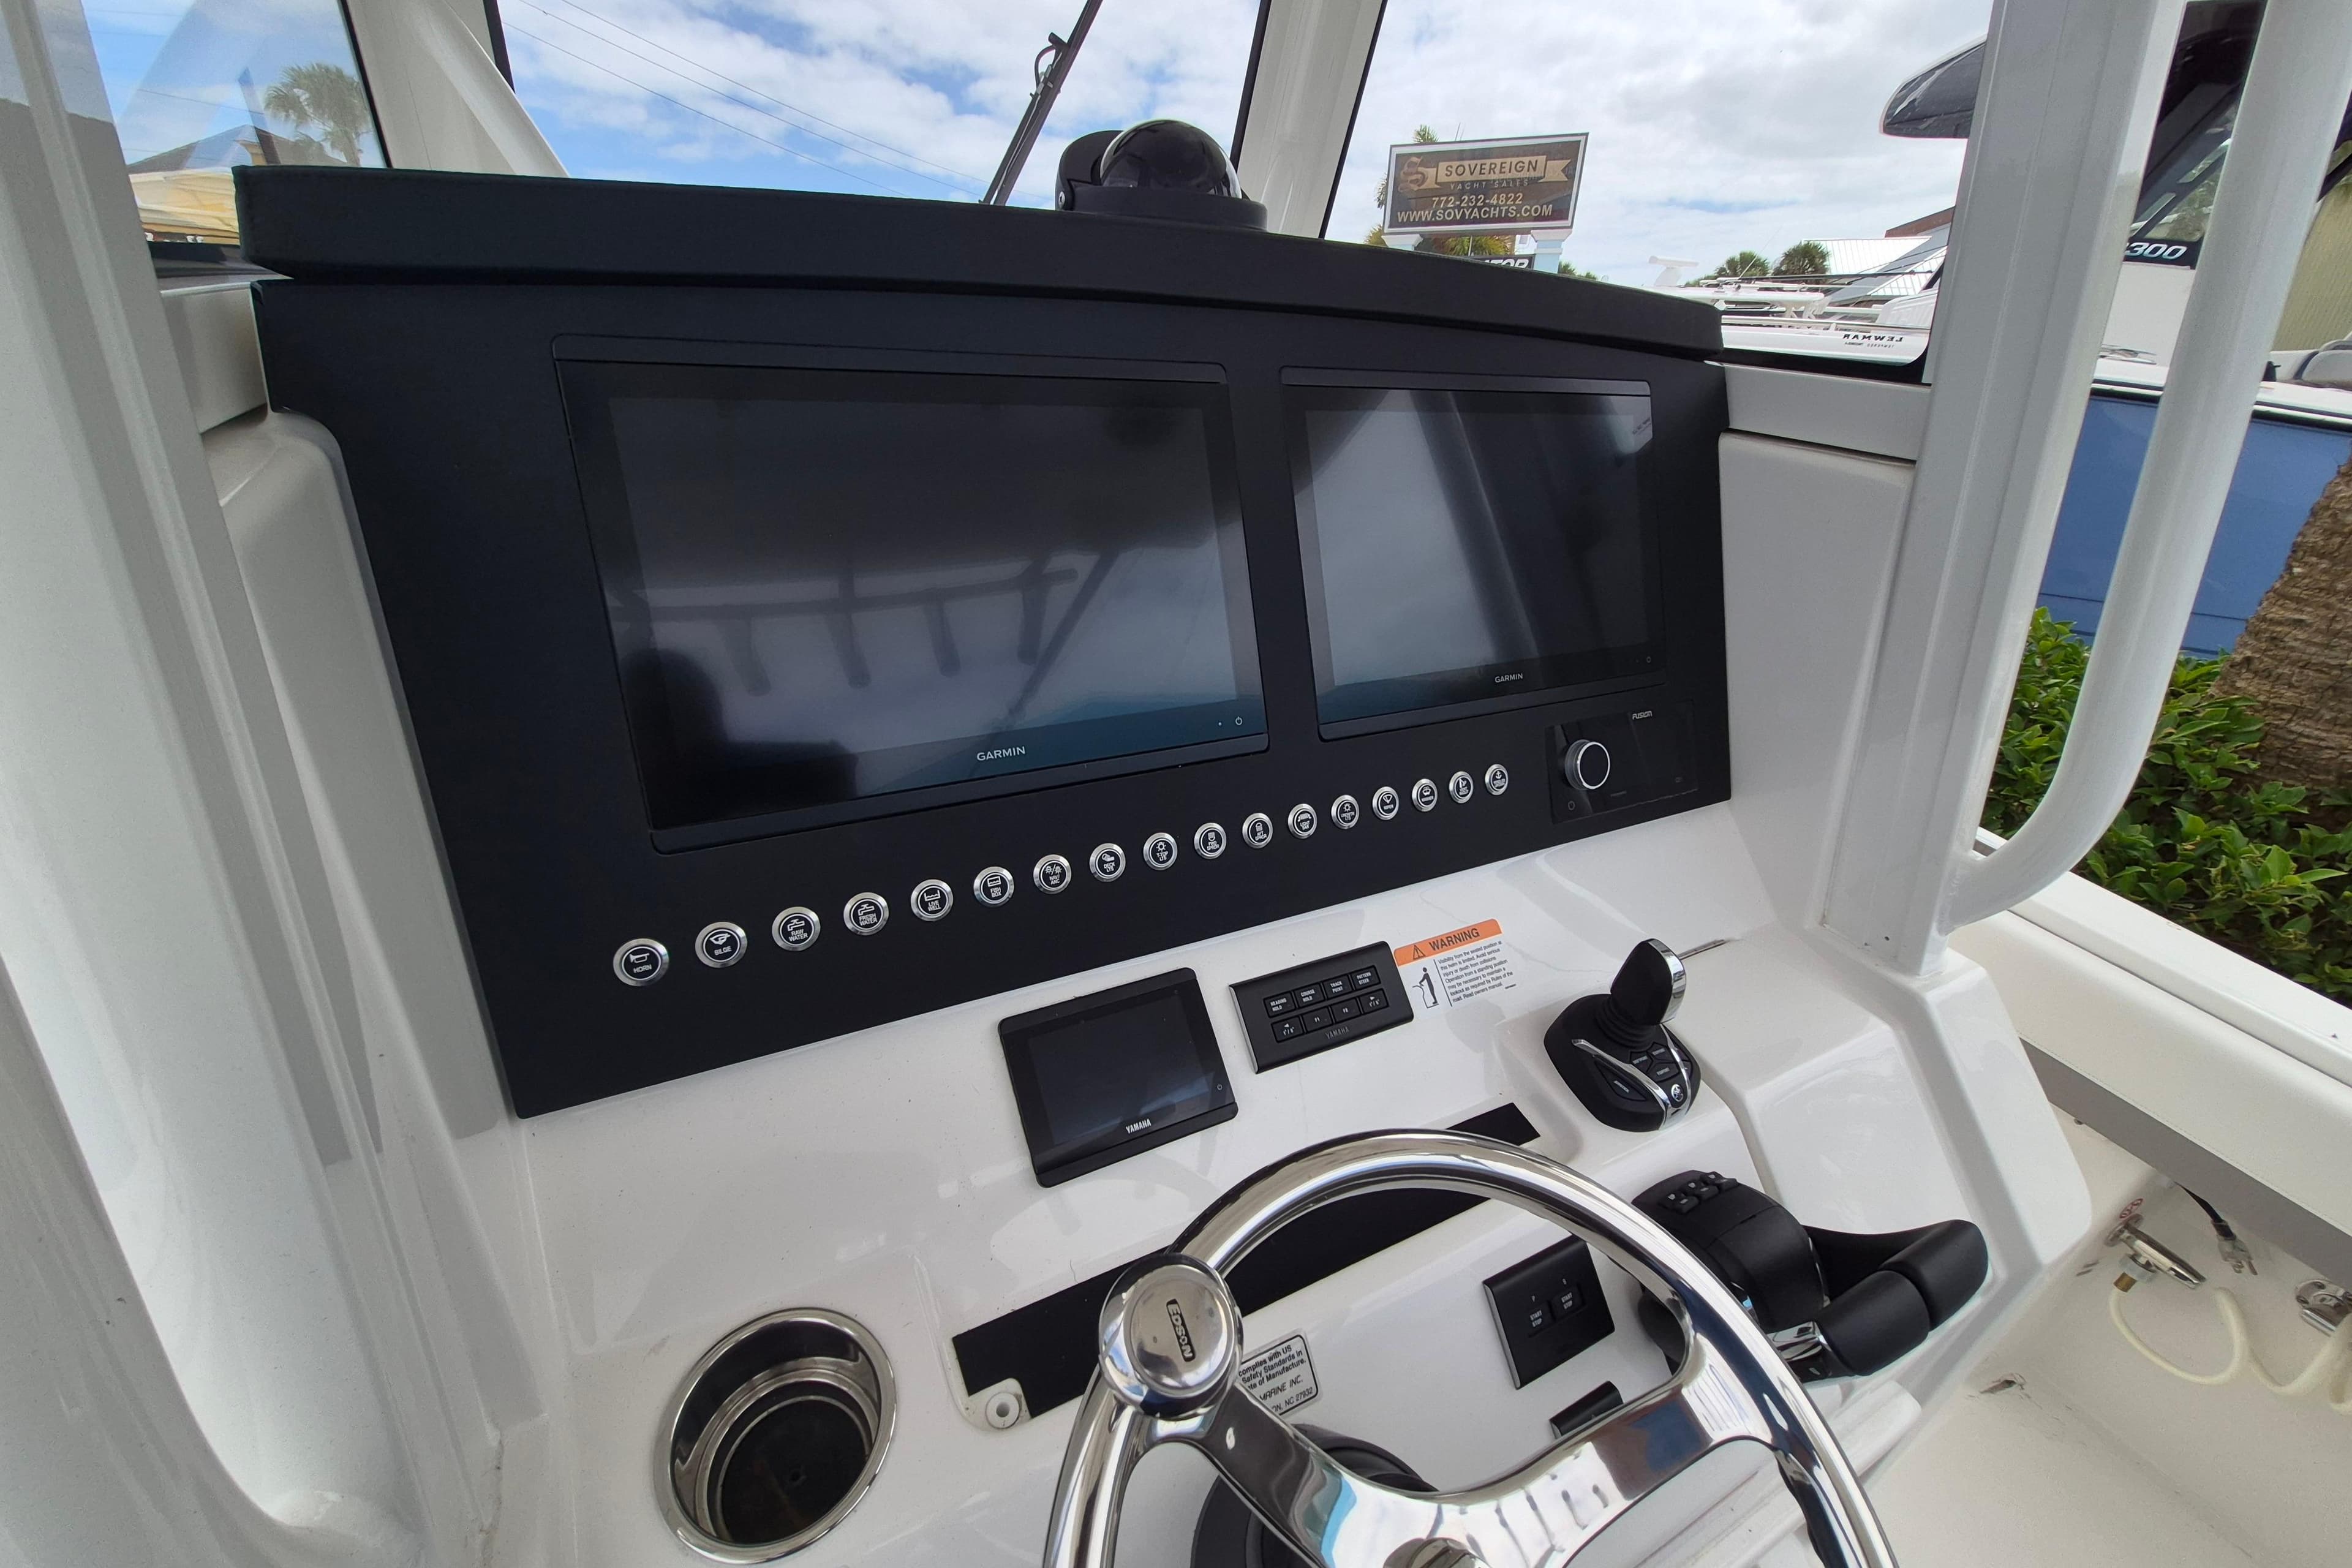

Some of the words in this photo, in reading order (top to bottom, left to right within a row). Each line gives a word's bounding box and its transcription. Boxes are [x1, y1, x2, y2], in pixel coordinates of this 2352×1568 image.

[1445, 159, 1538, 177] SOVEREIGN
[1450, 181, 1487, 190] YACHT
[1432, 193, 1523, 208] 772-232-4822
[1398, 205, 1552, 222] WWW.SOVYACHTS.COM
[1495, 673, 1523, 683] GARMIN
[1632, 710, 1653, 720] FUSION
[976, 745, 1026, 762] GARMIN
[789, 933, 808, 941] WATER
[1429, 928, 1480, 951] WARNING
[714, 946, 732, 956] BILGE
[633, 964, 652, 973] HORN
[1446, 974, 1464, 984] Operation
[1270, 998, 1287, 1006] HEADING
[1325, 1027, 1349, 1039] YAMAHA
[1126, 1118, 1152, 1134] YAMAHA
[1561, 1292, 1572, 1303] START
[1564, 1300, 1572, 1309] STOP
[1530, 1310, 1542, 1321] START
[1532, 1318, 1542, 1327] STOP
[1167, 1304, 1193, 1357] EDSON
[1238, 1359, 1267, 1378] complies
[1268, 1351, 1281, 1363] with
[1282, 1345, 1292, 1354] US
[1242, 1370, 1262, 1384] Safety
[1263, 1355, 1295, 1373] Standards
[1267, 1359, 1306, 1382] Manufacture.
[1289, 1375, 1303, 1388] INC.
[1285, 1397, 1294, 1406] NC
[1295, 1387, 1313, 1402] 27932
